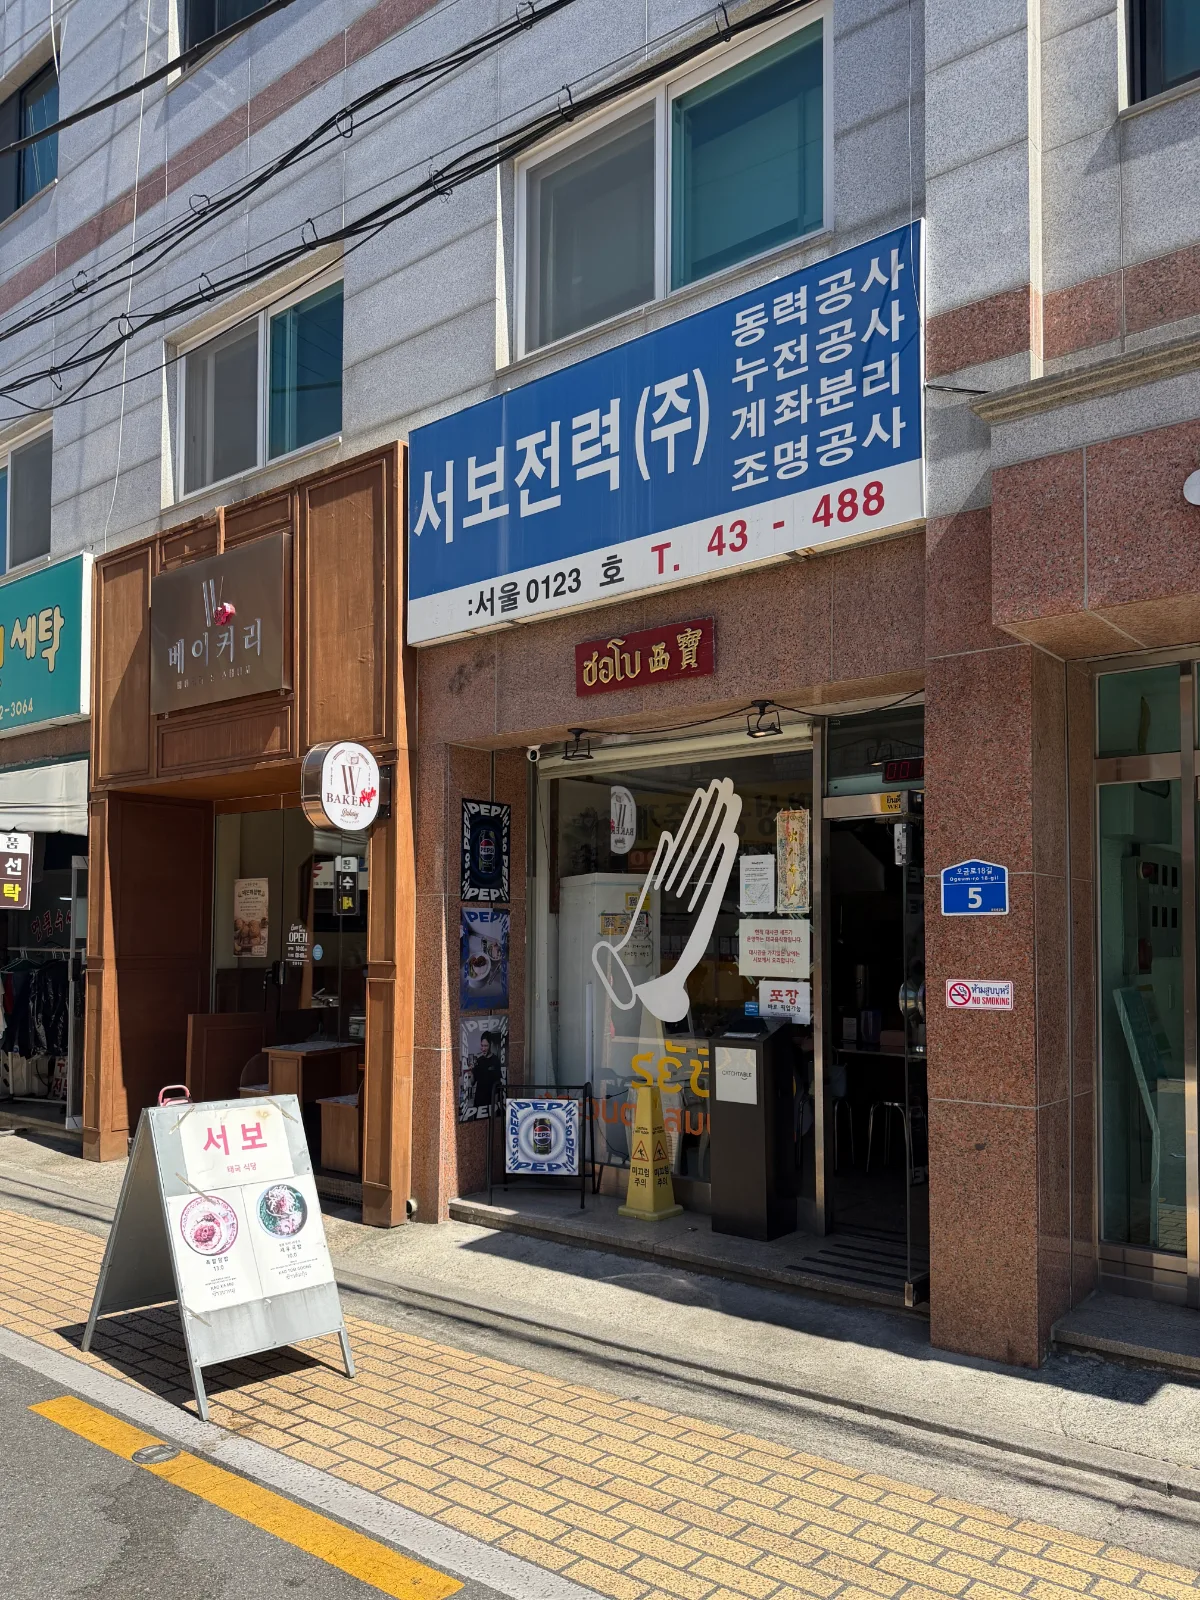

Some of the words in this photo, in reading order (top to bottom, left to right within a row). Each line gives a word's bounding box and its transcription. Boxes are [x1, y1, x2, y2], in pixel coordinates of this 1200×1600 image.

[732, 248, 904, 347] 동력공사
[732, 300, 905, 393] 누전공사
[730, 352, 900, 441] 계좌분리
[732, 406, 906, 491] 조명공사
[599, 554, 625, 587] 호
[651, 542, 680, 575] T.
[707, 519, 748, 556] 43
[812, 481, 885, 528] 488
[10, 604, 65, 673] 세탁
[168, 618, 262, 674] 베이커리
[967, 887, 983, 909] 5
[289, 931, 308, 943] OPEN
[769, 989, 799, 1005] 포장
[972, 996, 980, 1005] NO
[982, 997, 1010, 1006] SMOKING
[514, 1101, 571, 1112] PEP!
[227, 1163, 242, 1173] 태국
[243, 1161, 257, 1172] 식당
[513, 1162, 572, 1173] PEP!
[632, 1166, 650, 1178] 미끄럼
[634, 1177, 647, 1188] 주의
